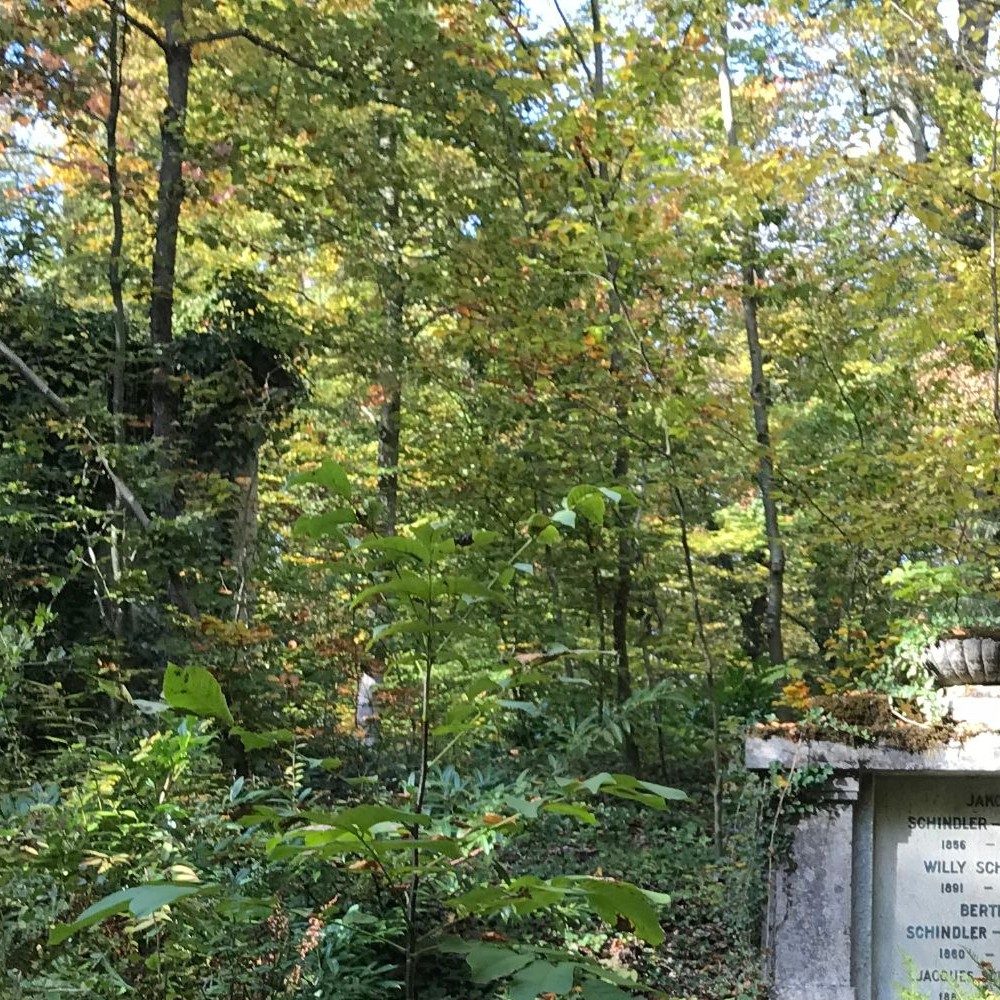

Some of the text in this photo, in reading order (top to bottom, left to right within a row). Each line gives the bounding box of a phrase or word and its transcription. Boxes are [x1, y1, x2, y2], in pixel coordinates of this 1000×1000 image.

[907, 816, 987, 830] SCHINDLER
[924, 860, 967, 874] WILLY
[941, 882, 963, 894] 1891
[906, 925, 987, 940] SCHINDLER
